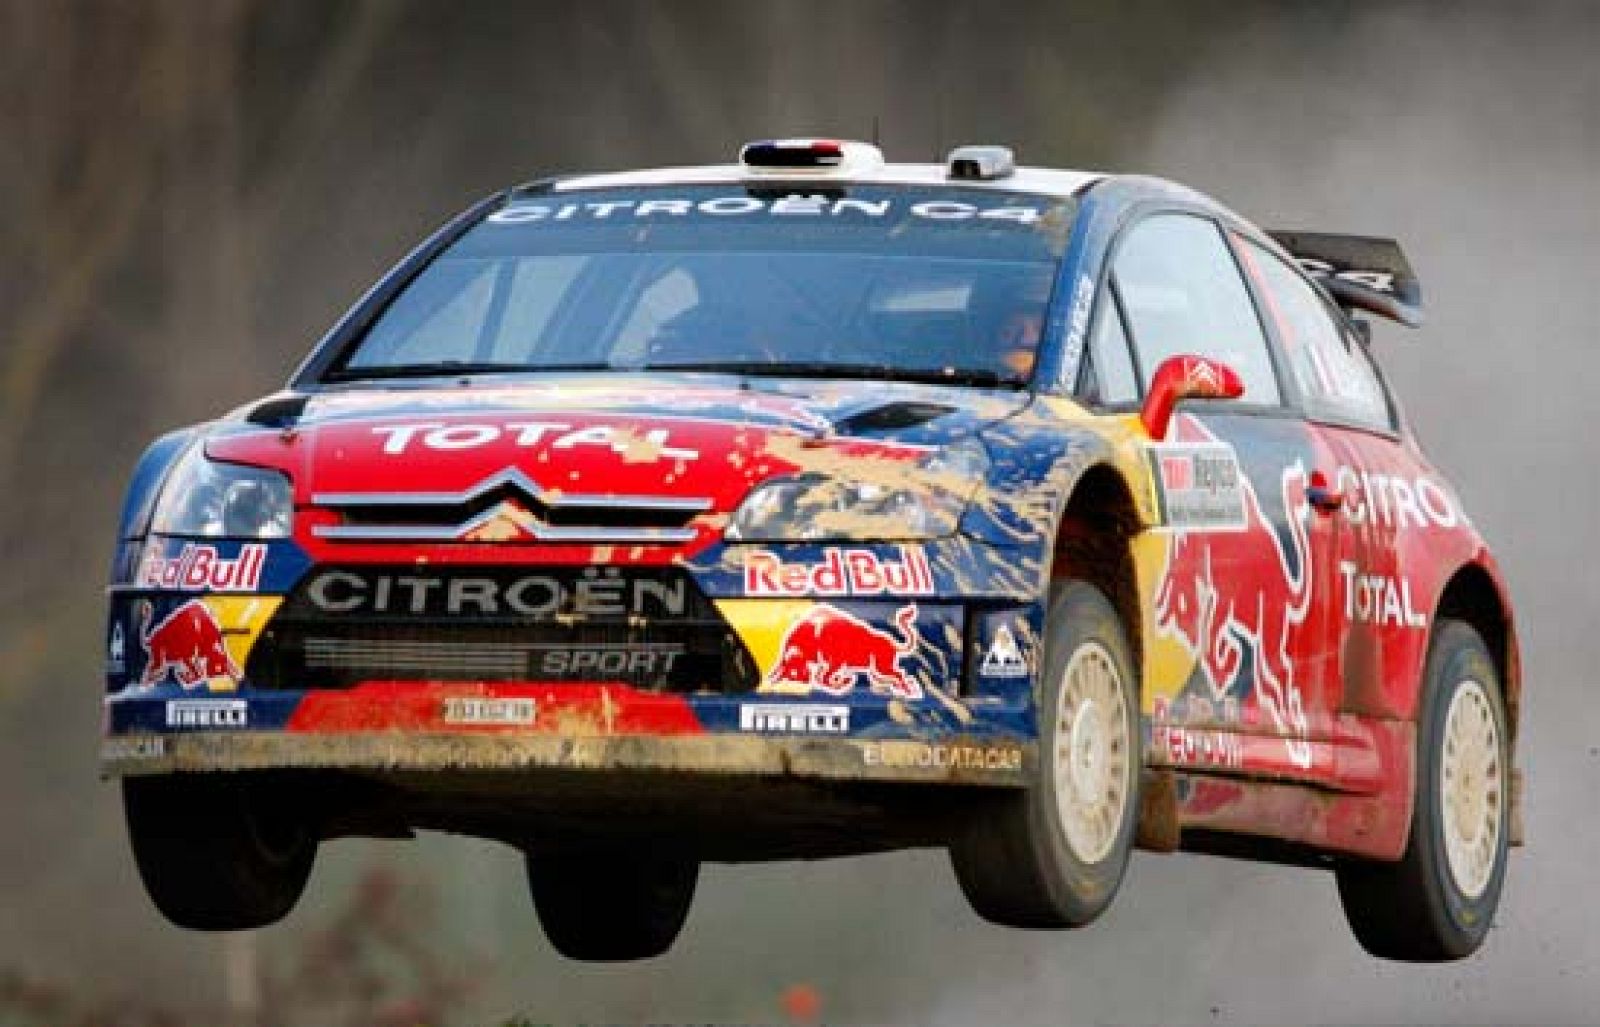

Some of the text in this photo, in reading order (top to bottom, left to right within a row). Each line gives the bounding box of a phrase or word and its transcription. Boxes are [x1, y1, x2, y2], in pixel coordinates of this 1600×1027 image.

[910, 200, 1043, 224] C4
[372, 424, 699, 460] TOTAL
[183, 544, 268, 590] Bull
[744, 544, 934, 594] Red Bull
[307, 566, 686, 616] CITROËN
[541, 650, 684, 674] SPORT
[741, 703, 850, 733] PIRELLI
